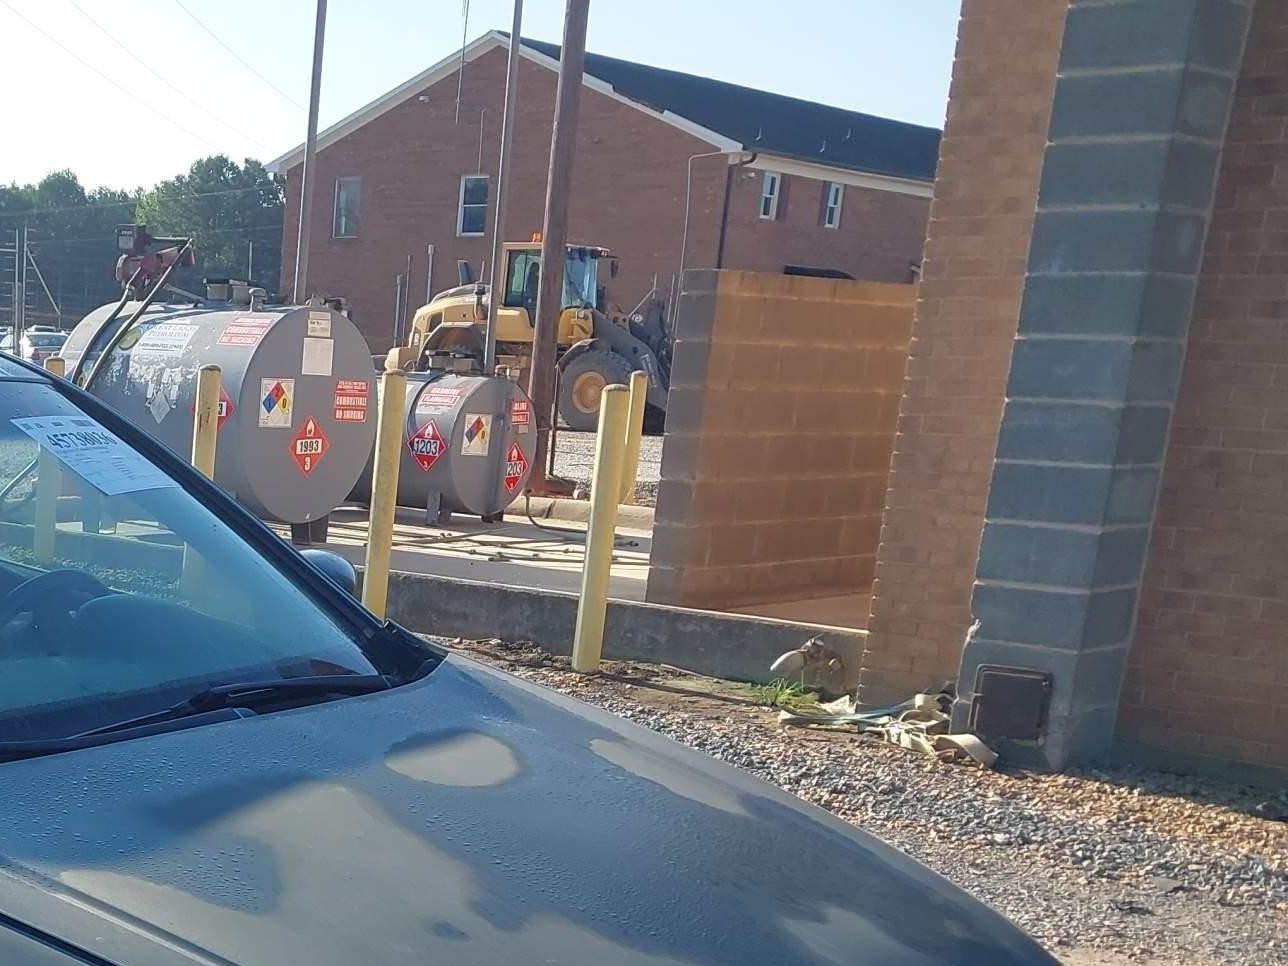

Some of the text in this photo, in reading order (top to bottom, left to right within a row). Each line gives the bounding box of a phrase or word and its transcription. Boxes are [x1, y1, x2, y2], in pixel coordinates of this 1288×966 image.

[46, 431, 118, 449] 45738036
[299, 440, 319, 452] 1993
[415, 440, 438, 455] 1203
[304, 456, 311, 470] 3
